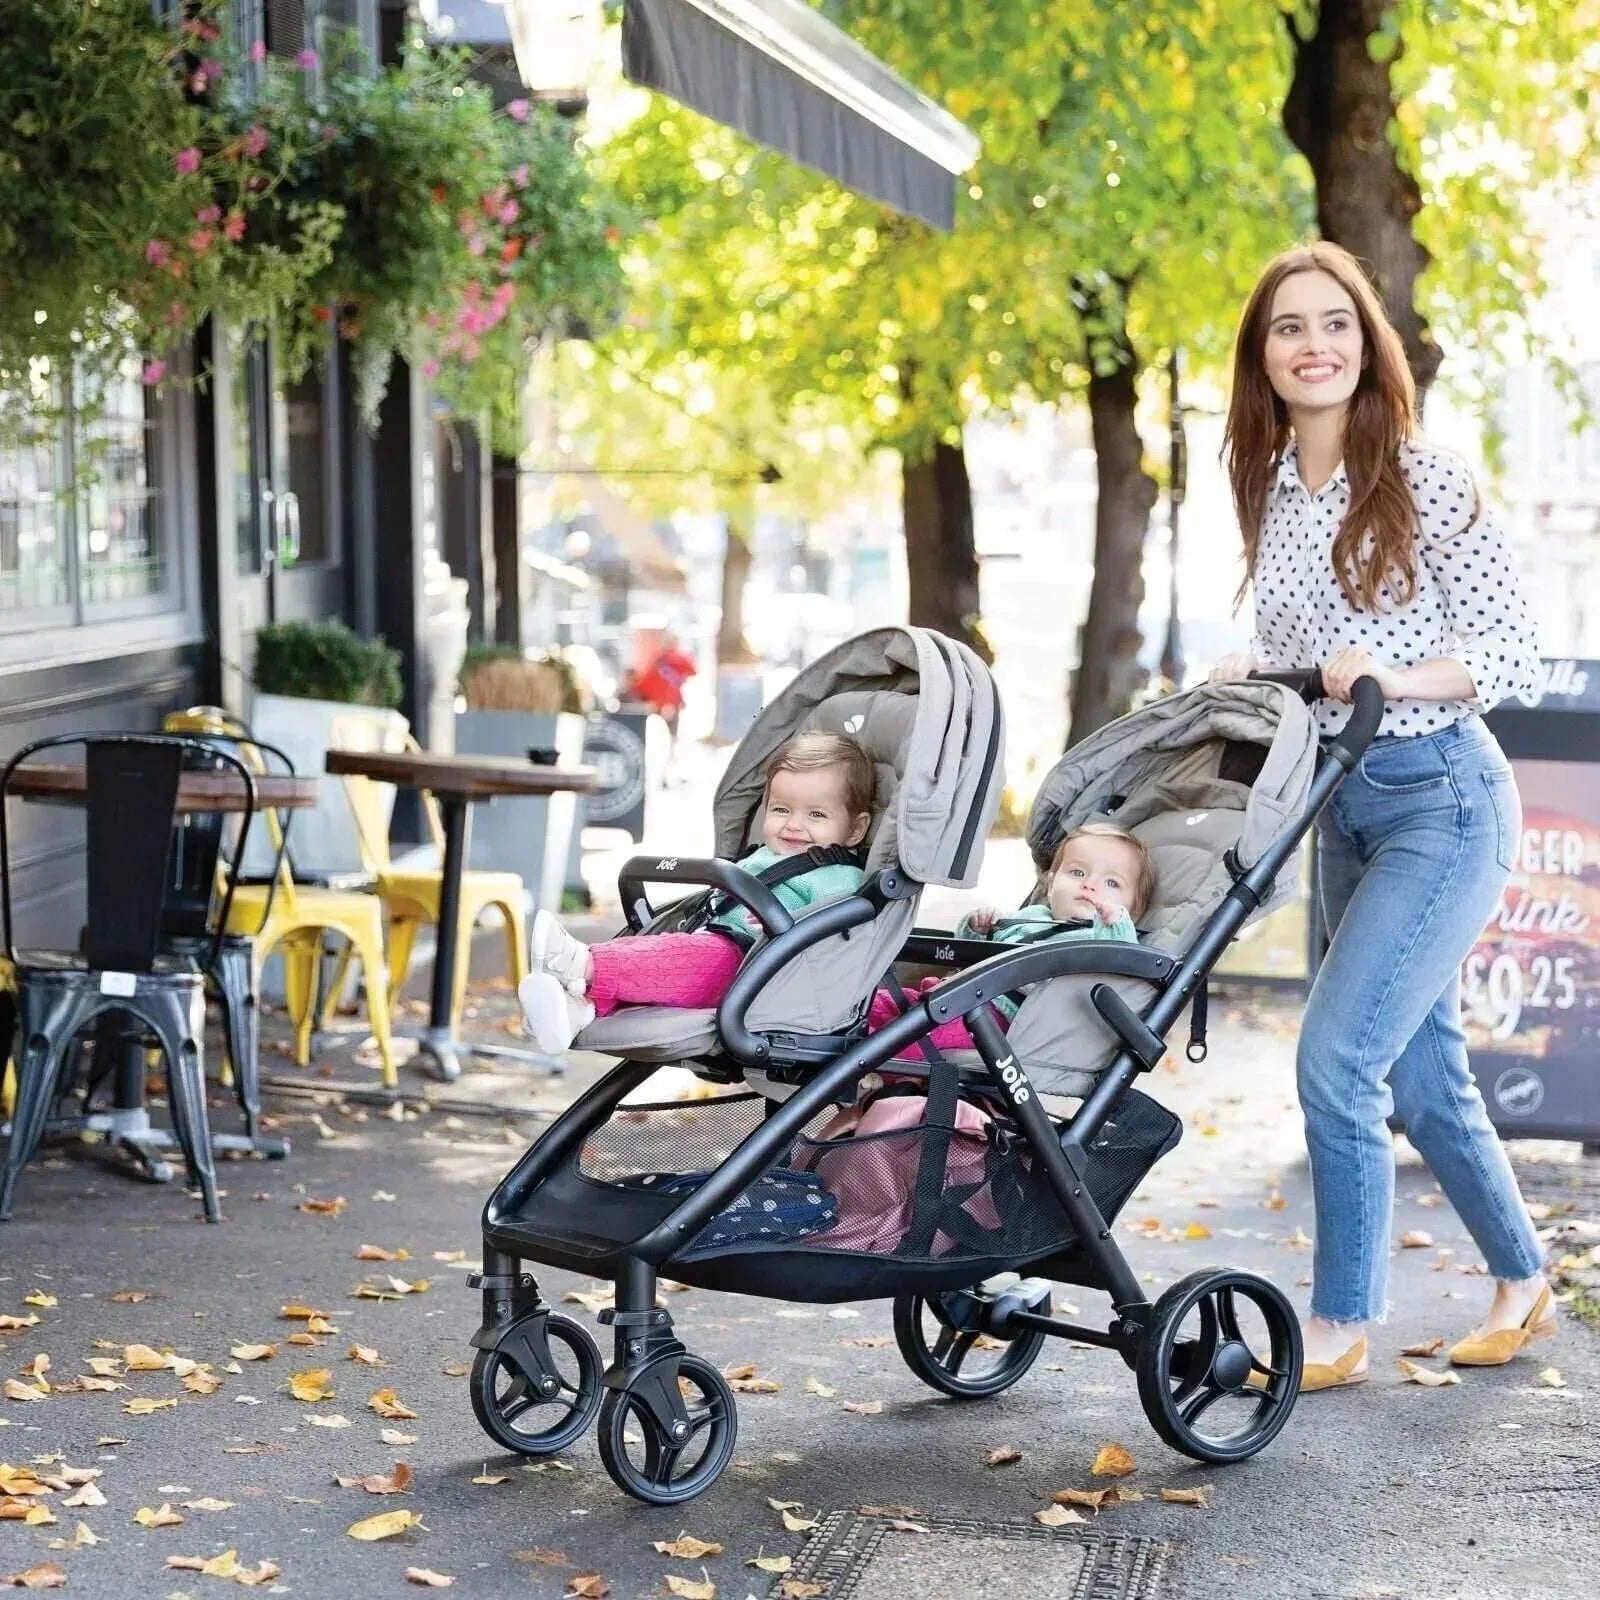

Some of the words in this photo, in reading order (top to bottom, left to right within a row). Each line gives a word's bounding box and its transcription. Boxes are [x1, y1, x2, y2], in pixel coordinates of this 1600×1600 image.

[656, 857, 678, 870] Joie
[1521, 828, 1583, 875] GER
[934, 944, 955, 960] Joie
[995, 1054, 1030, 1105] Joie
